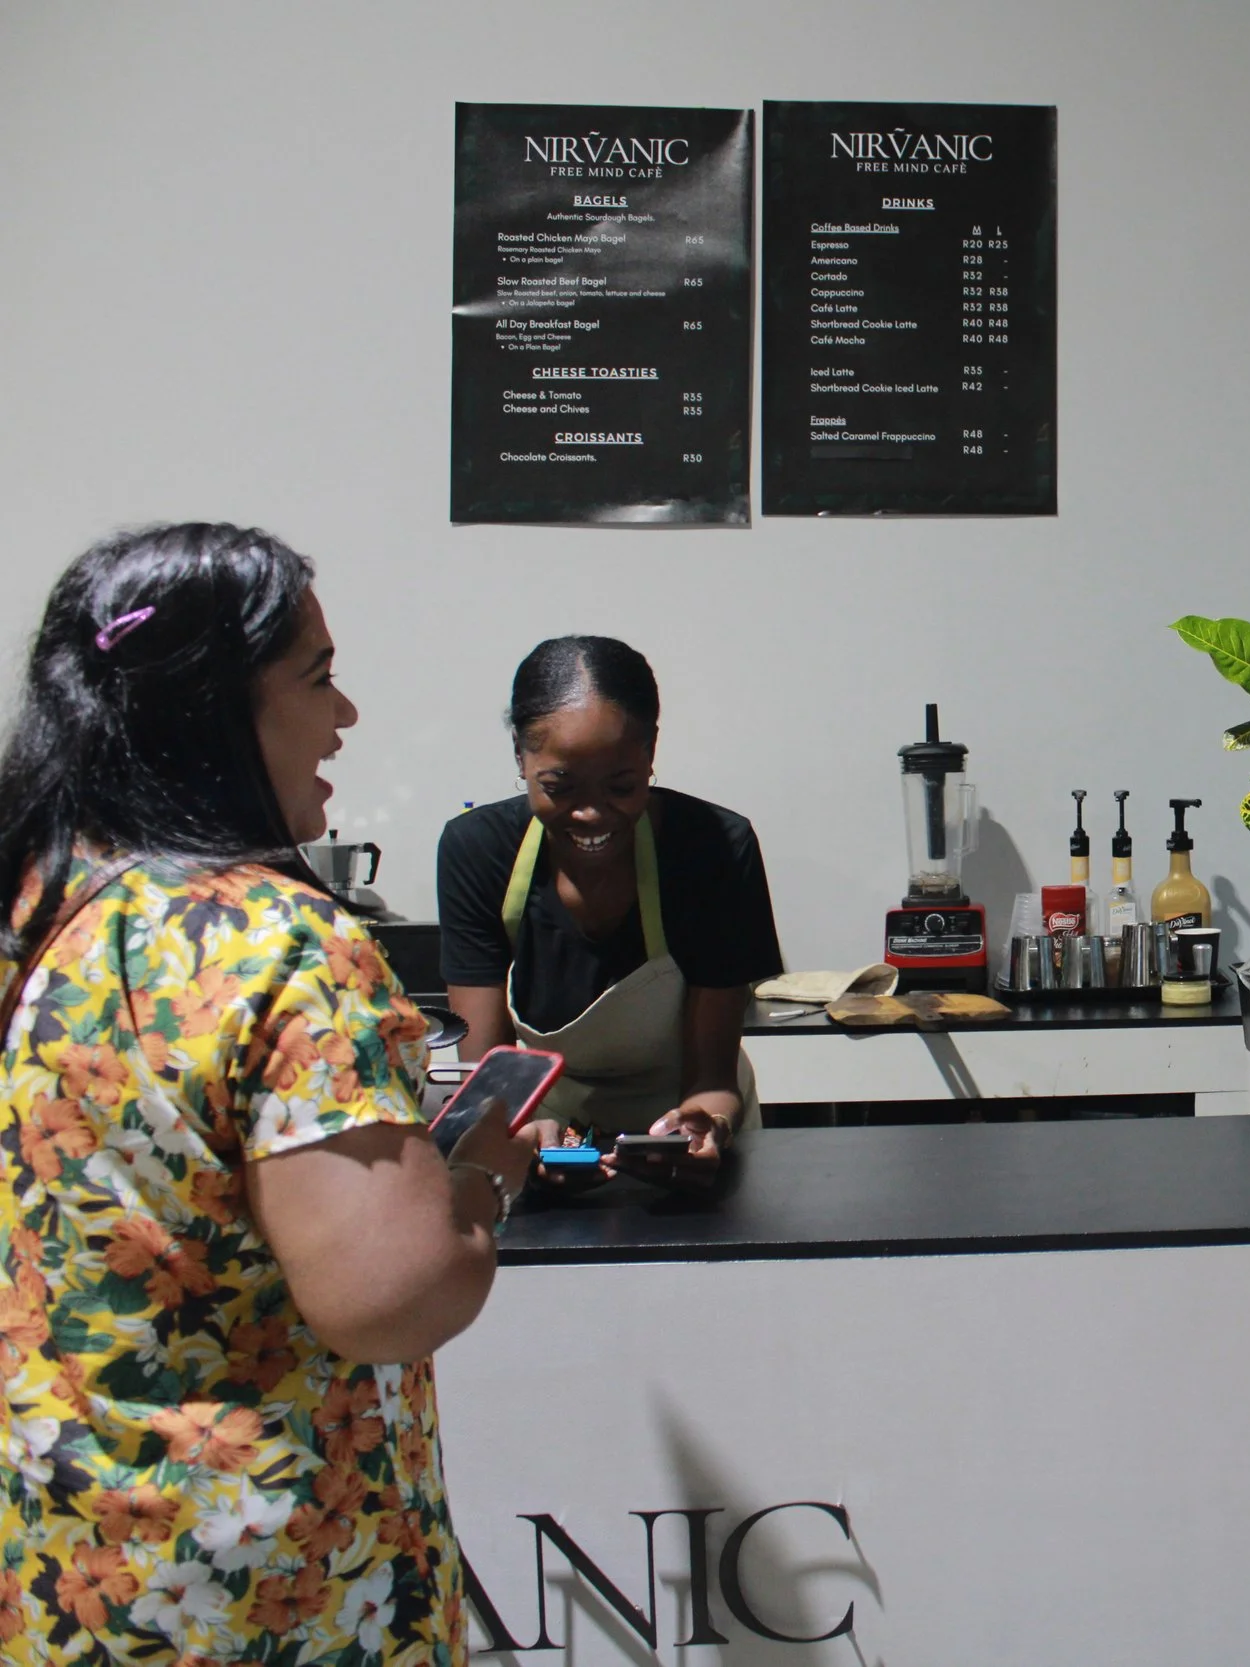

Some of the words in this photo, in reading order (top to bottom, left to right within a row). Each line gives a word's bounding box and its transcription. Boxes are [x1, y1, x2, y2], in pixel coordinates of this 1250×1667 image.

[551, 167, 582, 176] FREE
[589, 168, 623, 177] MIND
[857, 163, 888, 171] FREE
[894, 163, 928, 172] MIND
[574, 196, 628, 207] BAGELS
[882, 198, 935, 210] DRINKS
[547, 213, 583, 221] Authentic
[586, 213, 626, 224] Sourdough
[811, 223, 844, 233] Coffee
[843, 223, 873, 233] Based
[872, 224, 899, 233] Drinks
[973, 226, 981, 235] M
[997, 226, 1001, 235] L
[498, 233, 534, 241] Roasted
[537, 233, 572, 242] Chicken
[575, 233, 600, 244] Mayo
[601, 234, 625, 244] Bagel
[686, 236, 704, 244] R65
[498, 245, 528, 254] Rosemary
[811, 241, 849, 251] Espresso
[963, 240, 982, 248] R20
[989, 240, 1008, 248] R25
[545, 256, 563, 264] bagel
[963, 256, 982, 264] R28
[811, 272, 847, 280] Cortado
[963, 271, 982, 280] R32
[498, 277, 519, 285] Slow
[521, 277, 557, 285] Roasted
[560, 277, 579, 285] Beef
[582, 277, 606, 287] Bagel
[684, 278, 702, 286] R65
[811, 288, 864, 298] Cappuccino
[963, 287, 982, 295] R32
[990, 288, 1008, 296] R38
[811, 304, 833, 312] Café
[836, 304, 857, 312] Latte
[963, 303, 982, 311] R32
[990, 303, 1008, 311] R38
[496, 320, 507, 328] All
[510, 320, 527, 330] Day
[530, 320, 571, 328] Breakfast
[574, 320, 599, 331] Bagel
[684, 321, 702, 330] R65
[811, 320, 859, 328] Shortbread
[862, 320, 892, 328] Cookie
[963, 319, 982, 327] R40
[989, 319, 1008, 327] R48
[519, 333, 532, 341] Egg
[811, 336, 833, 344] Café
[835, 336, 865, 344] Mocha
[963, 335, 982, 343] R40
[989, 335, 1008, 343] R48
[543, 344, 561, 352] Bagel
[533, 368, 586, 379] CHEESE
[591, 368, 658, 379] TOASTIES
[811, 368, 829, 376] Iced
[832, 368, 854, 376] Latte
[964, 366, 982, 375] R35
[811, 384, 859, 392] Shortbread
[862, 384, 892, 392] Cookie
[895, 384, 914, 392] Iced
[916, 384, 938, 392] Latte
[963, 382, 982, 391] R42
[503, 390, 537, 399] Cheese
[539, 391, 546, 399] &
[549, 391, 581, 399] Tomato
[684, 393, 702, 401] R35
[503, 404, 537, 413] Cheese
[540, 404, 557, 413] and
[560, 404, 589, 413] Chives
[684, 407, 702, 415] R35
[810, 416, 846, 426] Frappés
[555, 433, 643, 444] CROISSANTS
[811, 432, 839, 440] Salted
[842, 432, 879, 440] Caramel
[882, 432, 935, 442] Frappuccino
[964, 430, 982, 438] R48
[964, 446, 982, 454] R48
[500, 452, 546, 461] Chocolate
[683, 454, 702, 462] R30
